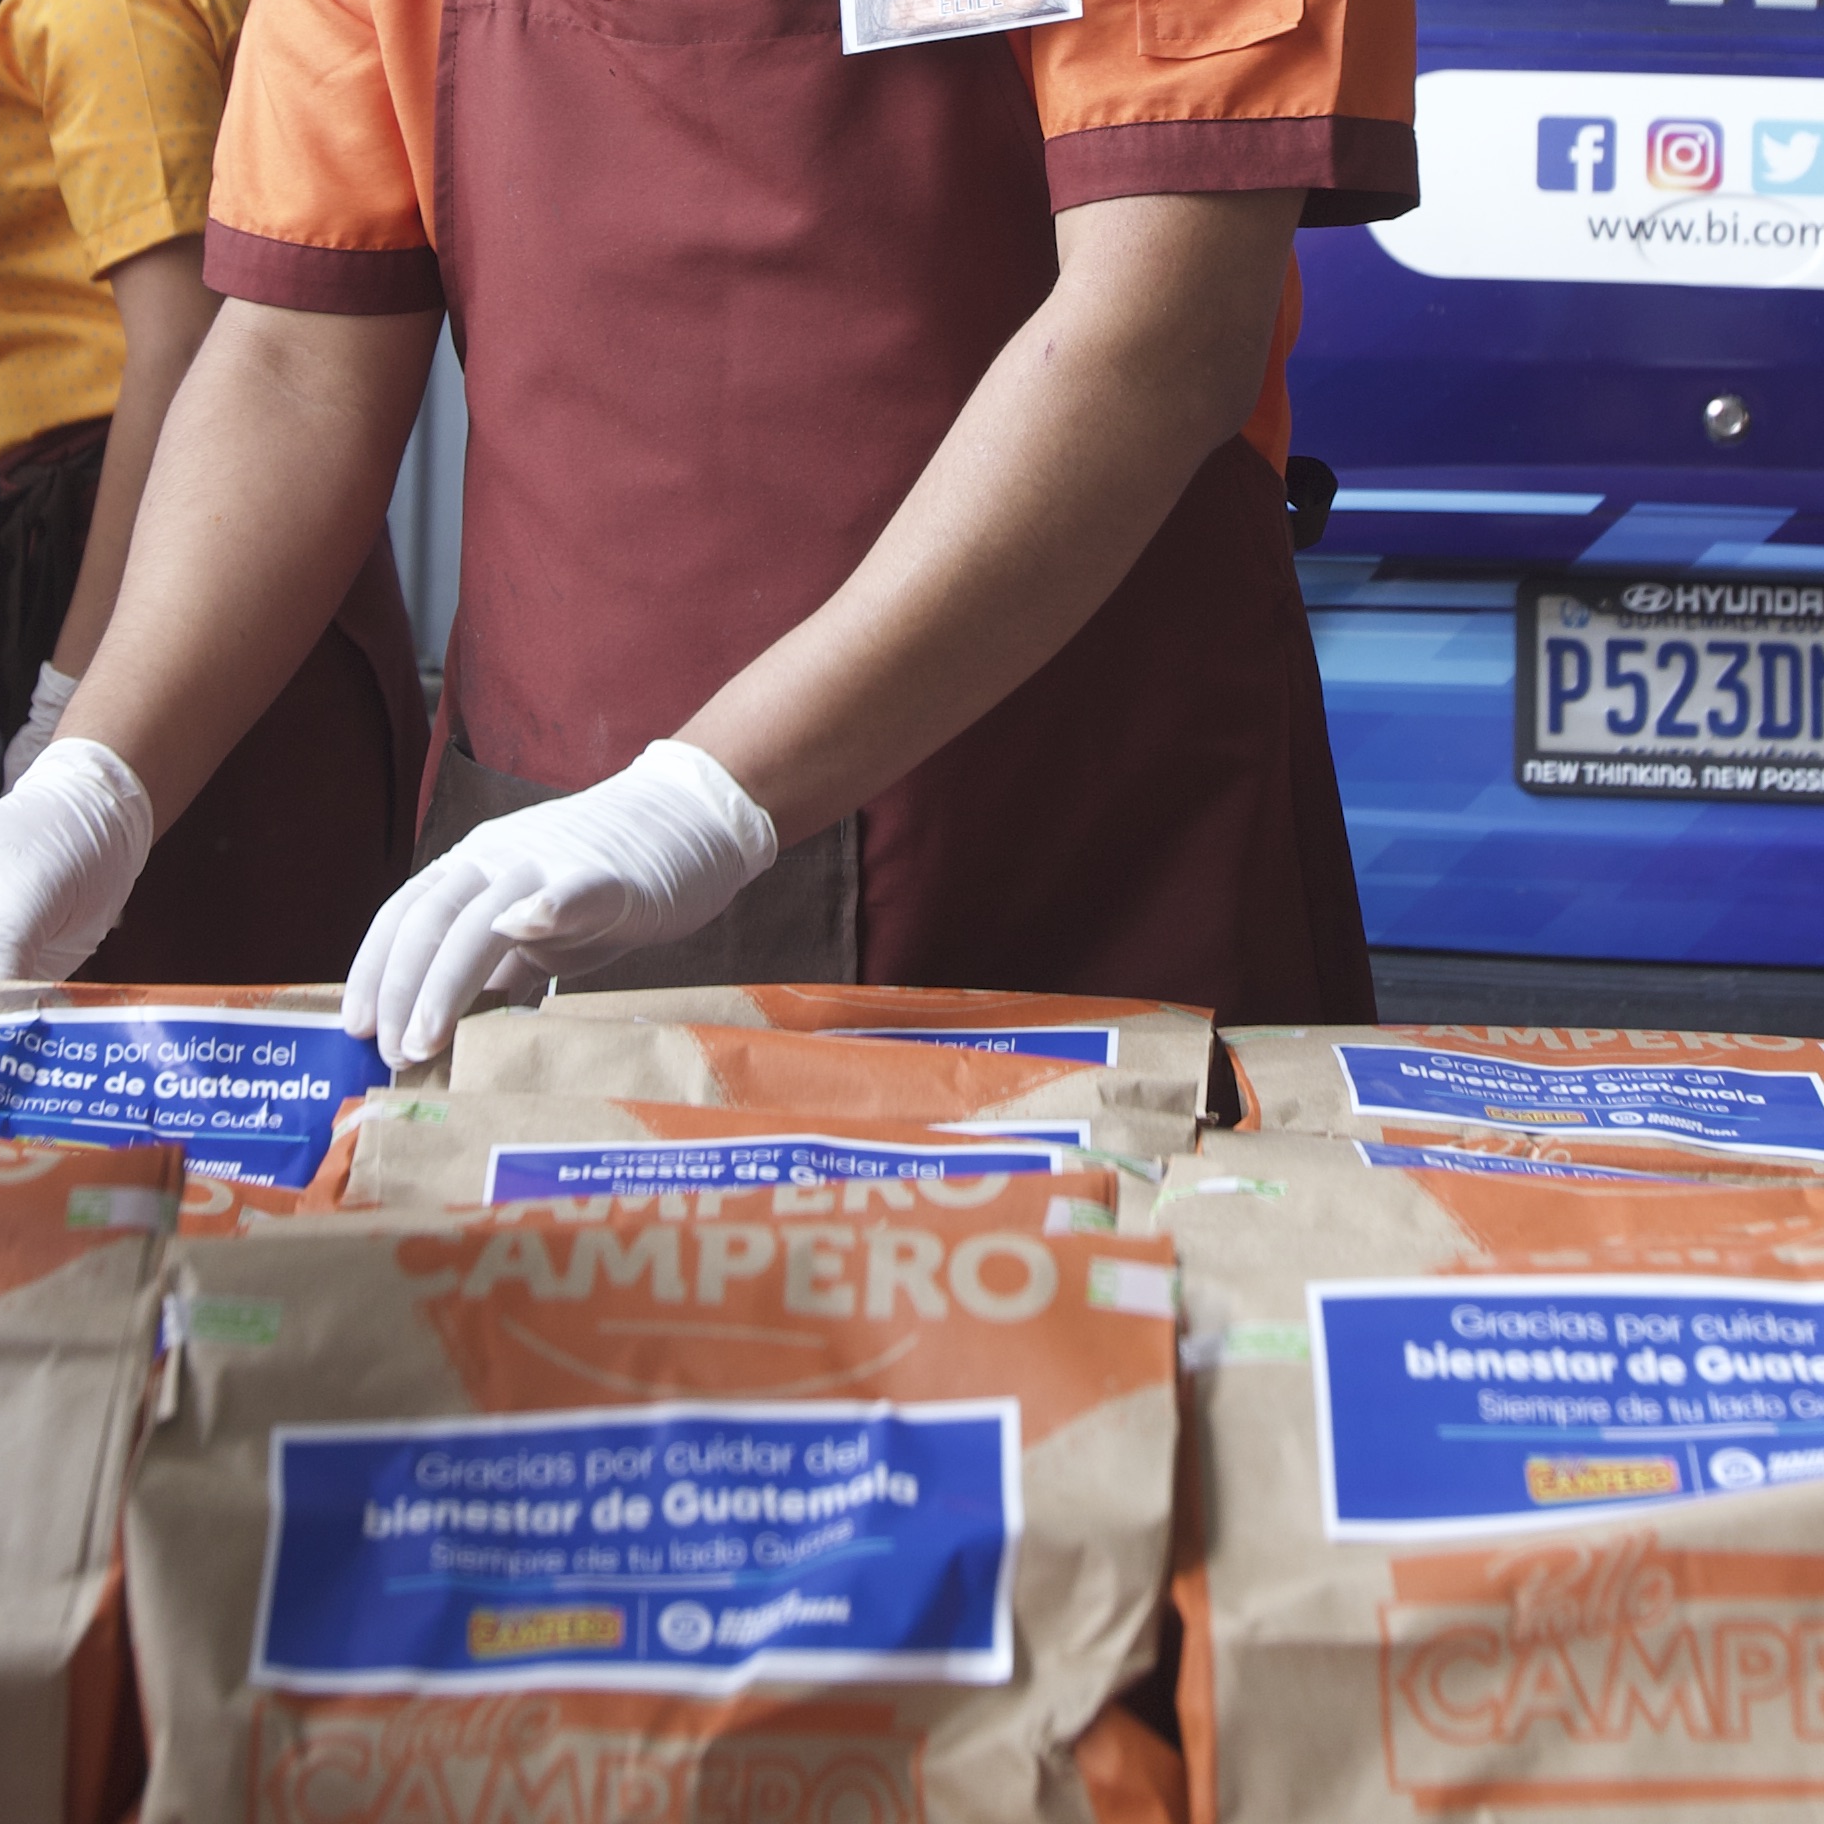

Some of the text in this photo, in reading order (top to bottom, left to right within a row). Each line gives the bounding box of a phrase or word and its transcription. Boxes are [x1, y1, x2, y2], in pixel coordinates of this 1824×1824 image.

[1523, 760, 1578, 784] NEW
[1702, 764, 1758, 790] NEW
[104, 1038, 151, 1068] por
[157, 1035, 246, 1065] cuidar
[252, 1040, 297, 1067] del
[104, 1068, 146, 1097] de
[153, 1070, 332, 1101] Guatemala
[1400, 1062, 1766, 1106] bienestar de Guatemala
[1430, 1055, 1533, 1084] Gracias
[1683, 1071, 1726, 1087] del
[87, 1097, 121, 1120] de
[125, 1100, 149, 1122] tu
[152, 1108, 206, 1129] lado
[1662, 1095, 1730, 1114] Guate
[897, 1158, 945, 1180] del
[384, 1221, 1060, 1323] CAMPERO
[1450, 1303, 1609, 1341] Gracias
[1614, 1309, 1682, 1348] por
[1690, 1306, 1819, 1346] cuidar
[1403, 1339, 1619, 1383] bienestar
[1626, 1345, 1687, 1387] de
[415, 1432, 870, 1491] Gracias por cuidar del
[362, 1460, 920, 1540] bienestar de Guatemala
